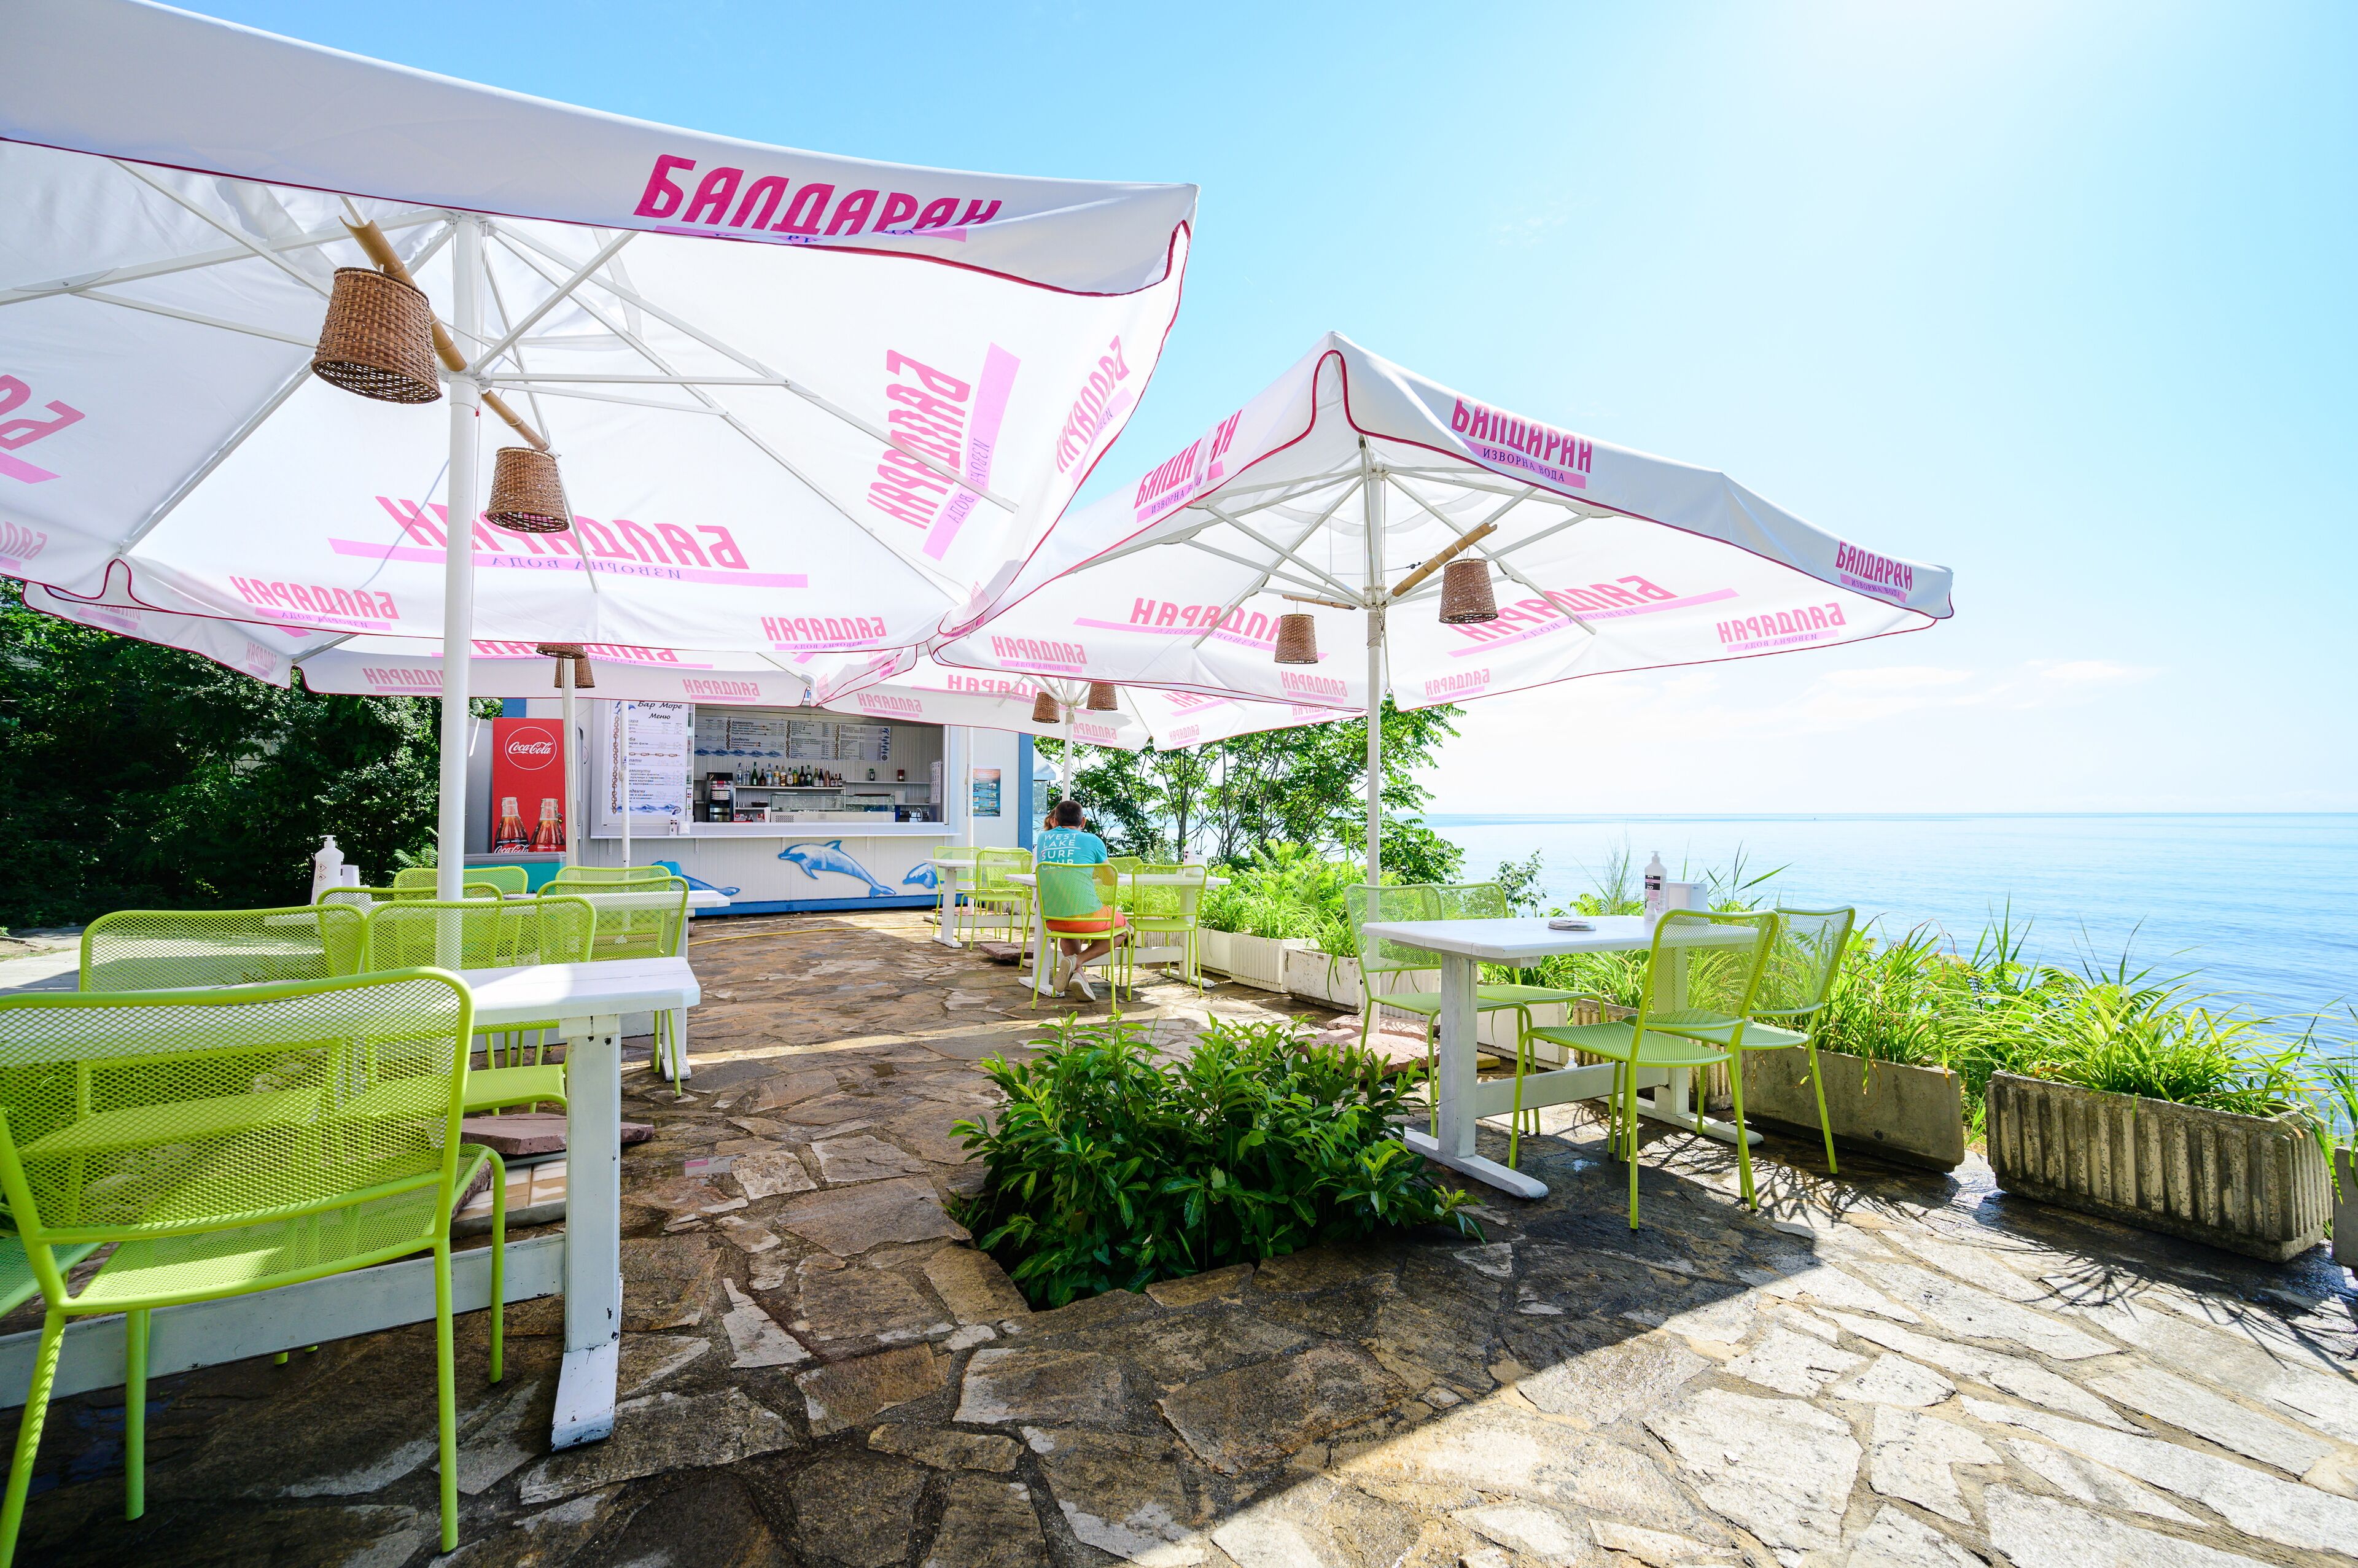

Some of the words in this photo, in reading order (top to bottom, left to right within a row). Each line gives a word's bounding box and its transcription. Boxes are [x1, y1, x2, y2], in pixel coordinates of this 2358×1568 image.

[633, 154, 1002, 236] БАЛДАРАН
[1451, 395, 1592, 473] БАЛДАРАН
[1134, 409, 1242, 509] БАЛДААН
[1483, 448, 1535, 471] ИЗВОРНА
[1539, 465, 1565, 482] ВОДА
[1151, 489, 1185, 514] ИЗВОРНА
[1835, 540, 1913, 591] БАЛДАРАН
[1851, 579, 1882, 593] ИЗВОРНА
[638, 701, 655, 710] Бар
[659, 702, 683, 711] Море
[508, 741, 553, 755] Coca-Cola
[1041, 849, 1075, 861] SURF
[1043, 839, 1075, 848] LAKE
